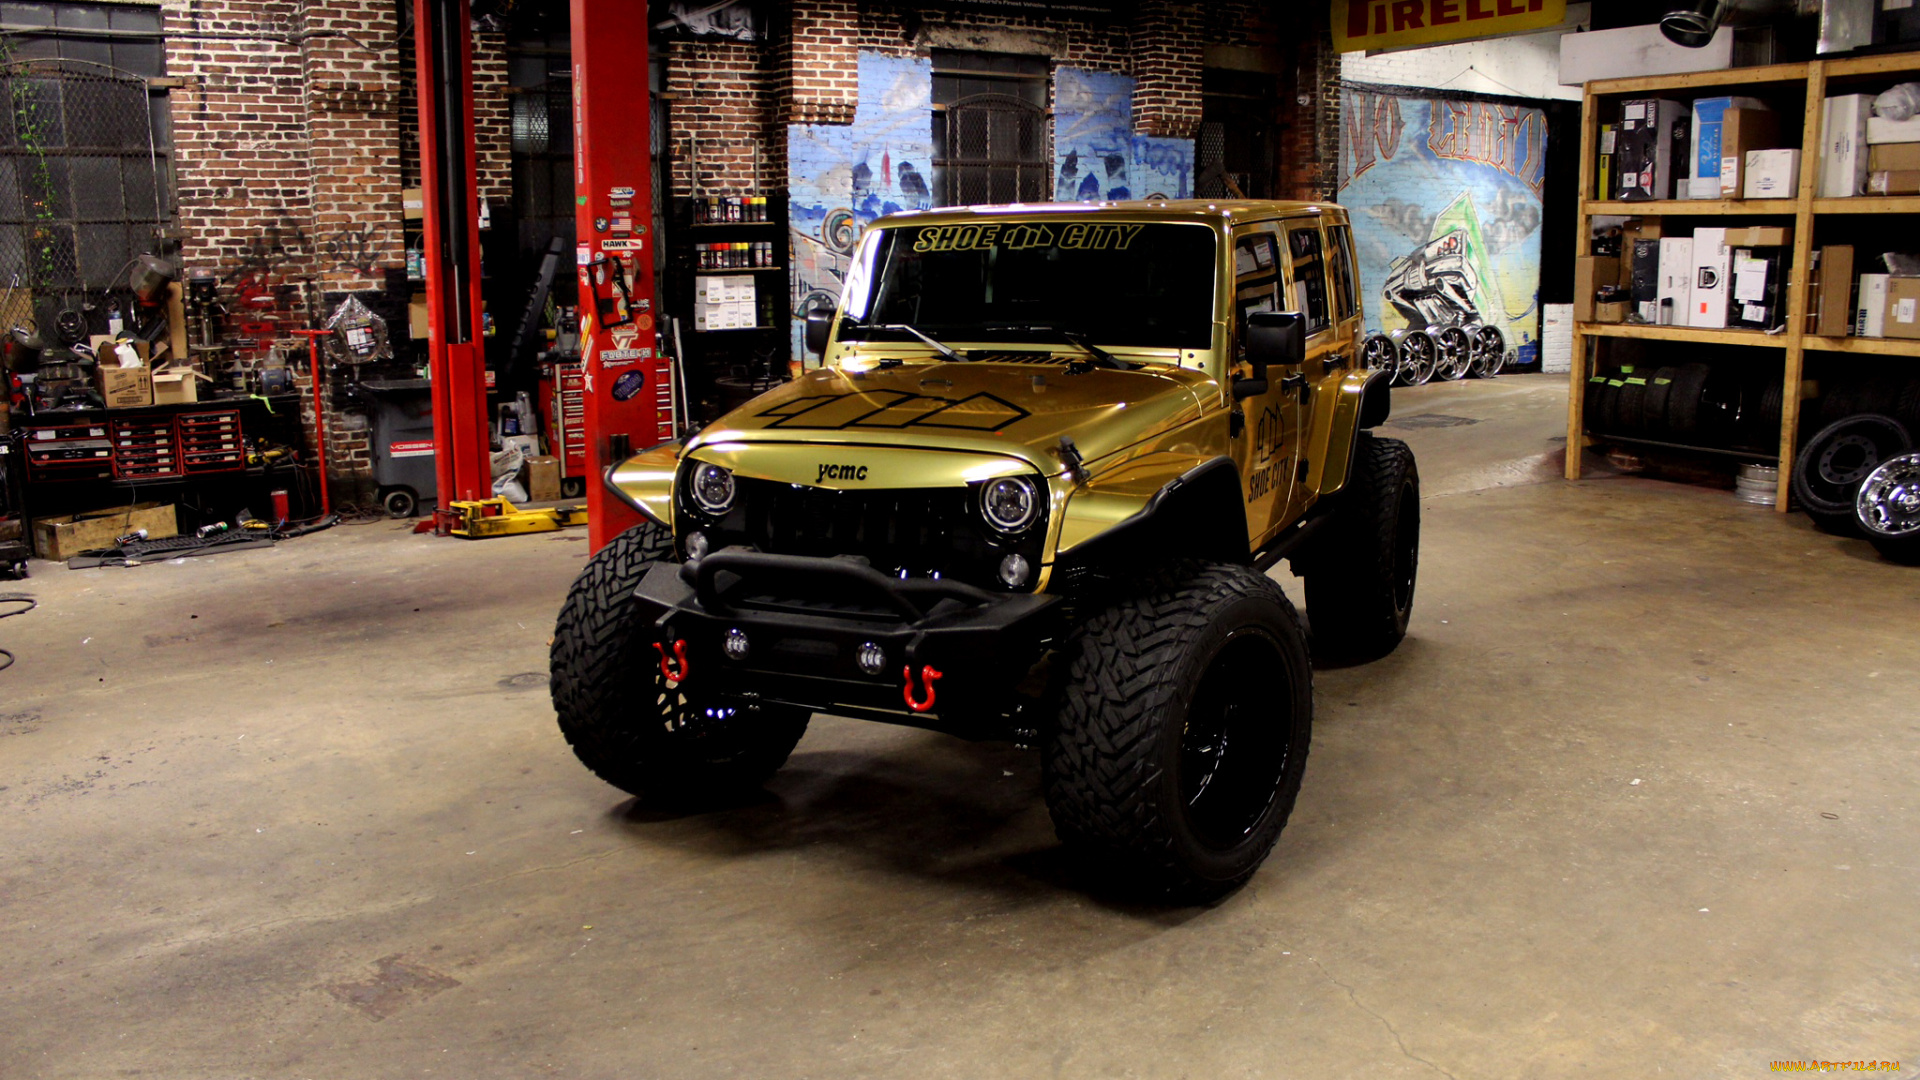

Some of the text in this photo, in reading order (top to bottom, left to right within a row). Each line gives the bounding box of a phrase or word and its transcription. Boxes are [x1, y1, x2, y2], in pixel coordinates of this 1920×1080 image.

[602, 240, 628, 248] HAWK
[913, 223, 1145, 252] SHOE CITY
[815, 464, 868, 483] ycmc
[1248, 455, 1289, 503] SHOE CITY
